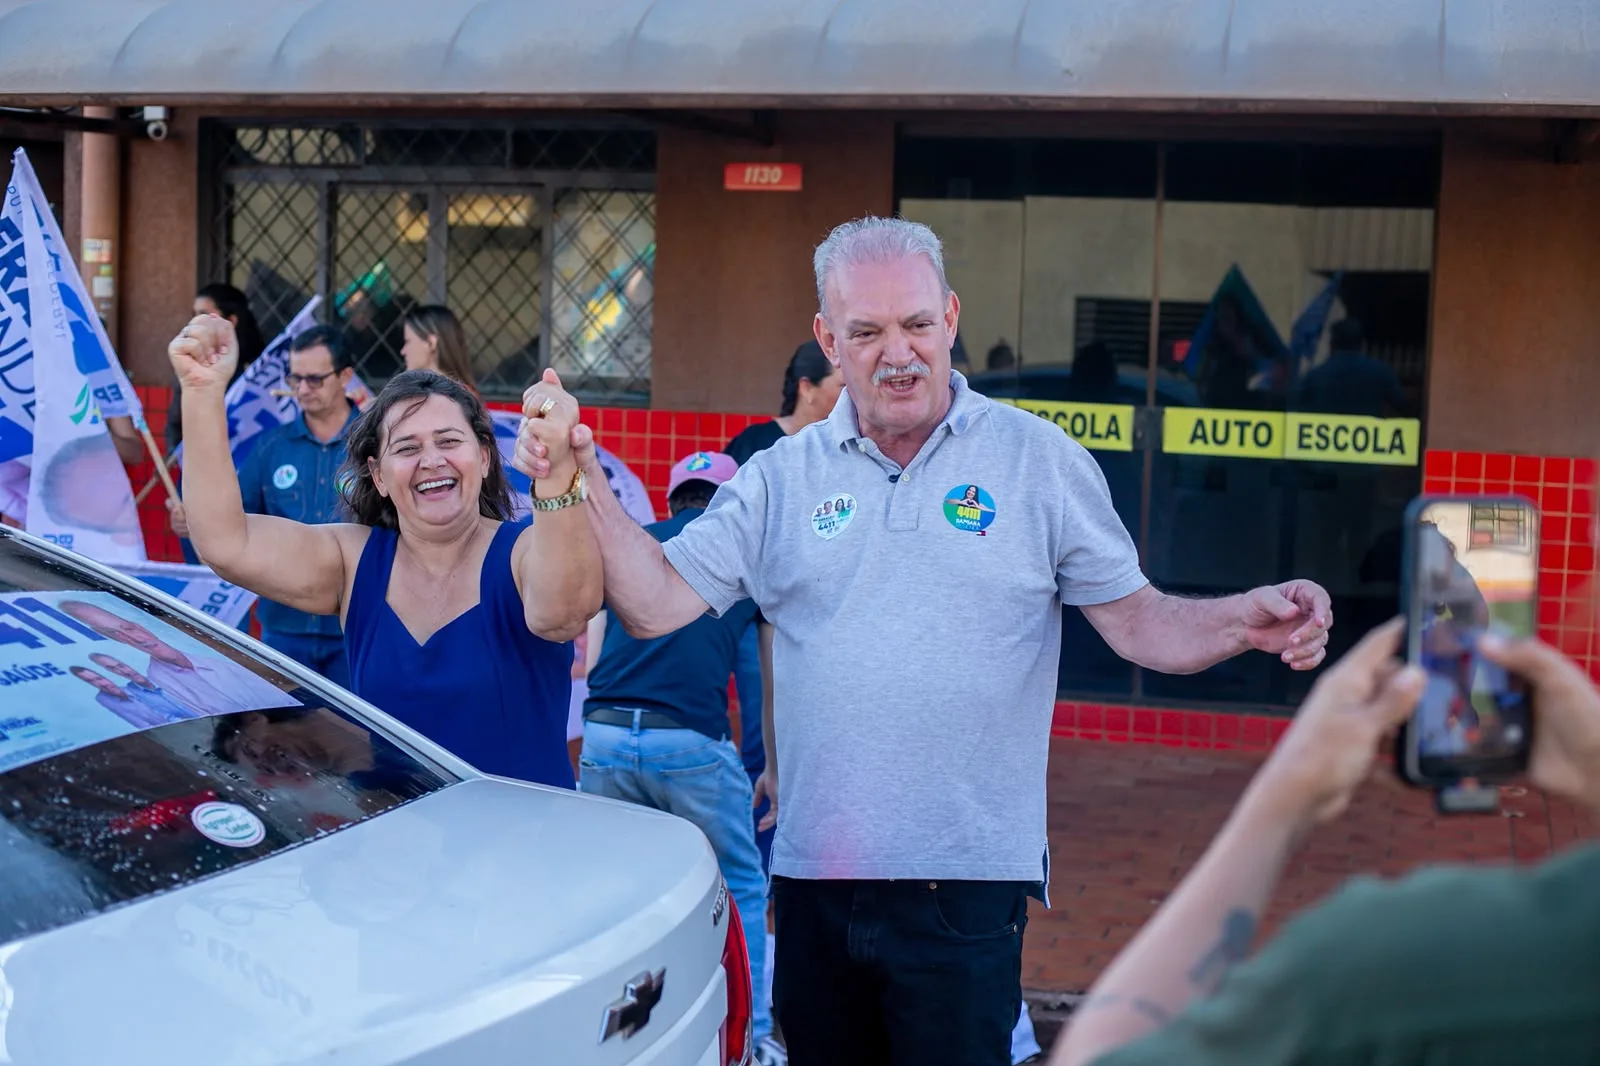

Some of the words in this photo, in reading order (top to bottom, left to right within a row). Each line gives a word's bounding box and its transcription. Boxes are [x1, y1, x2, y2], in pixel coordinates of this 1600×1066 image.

[743, 166, 783, 185] 1130
[1023, 409, 1121, 441] COLA
[1189, 417, 1274, 448] AUTO
[1297, 422, 1406, 456] ESCOLA
[817, 520, 836, 531] 4411
